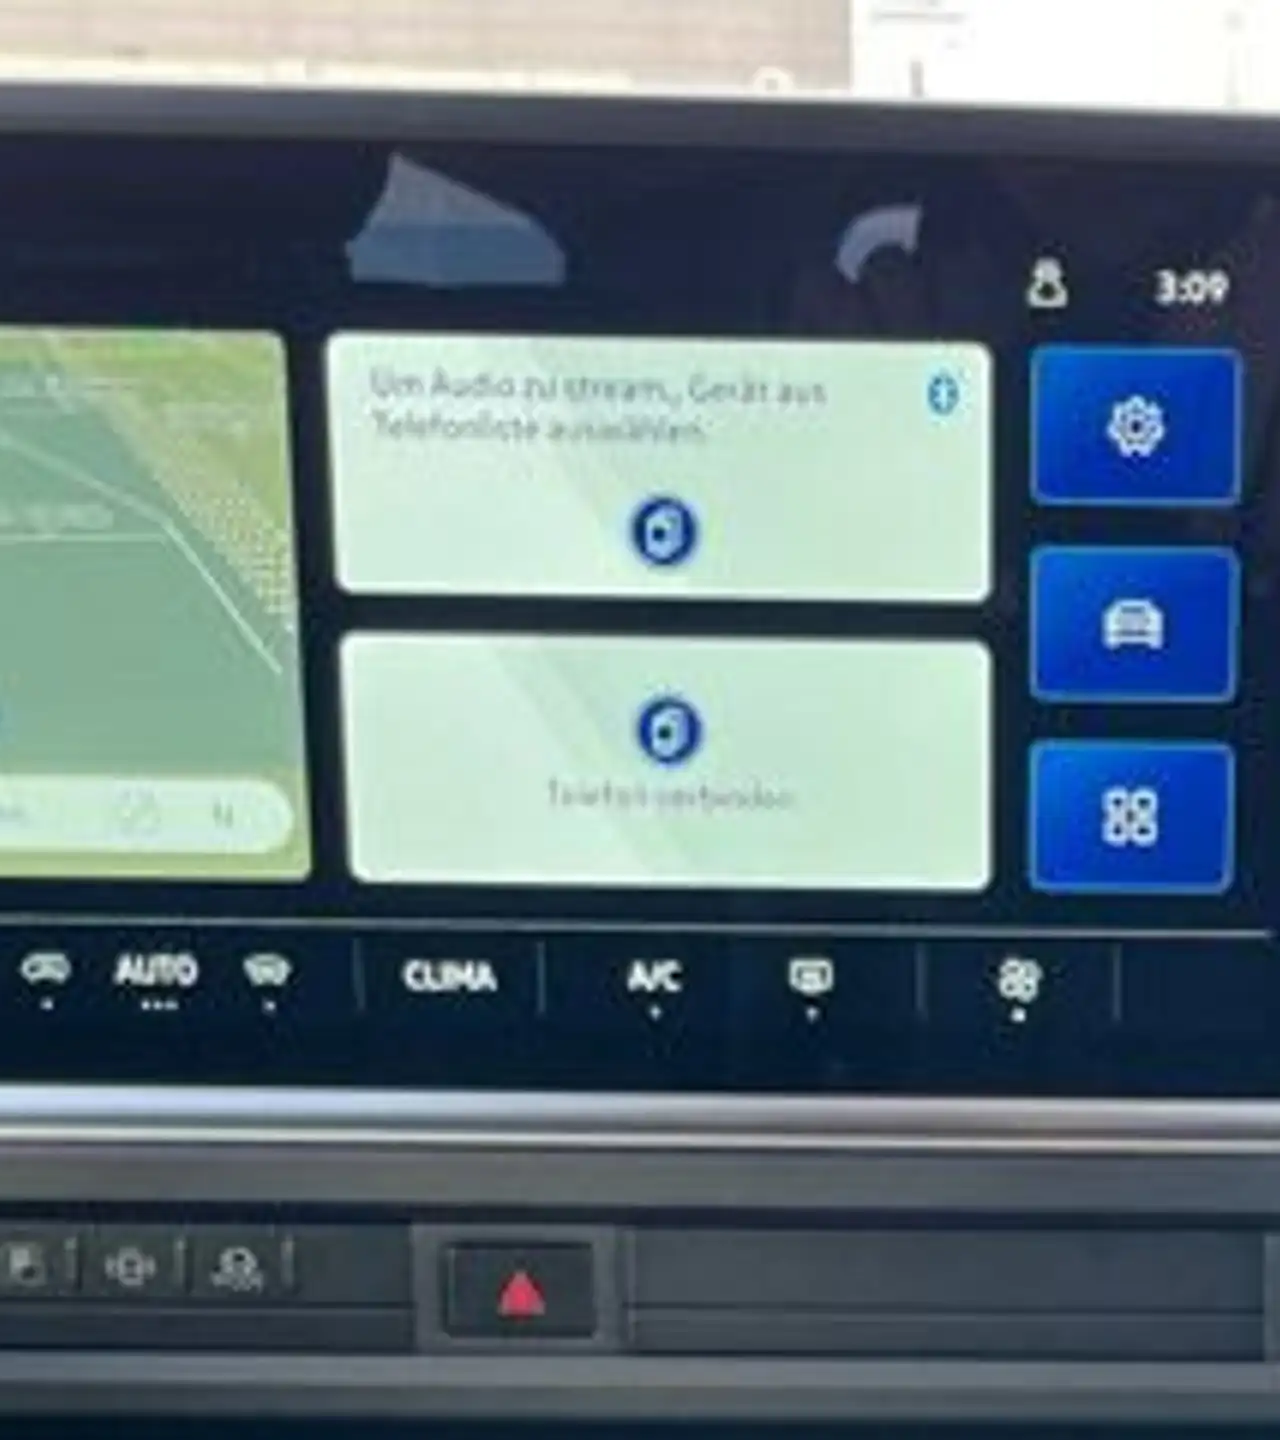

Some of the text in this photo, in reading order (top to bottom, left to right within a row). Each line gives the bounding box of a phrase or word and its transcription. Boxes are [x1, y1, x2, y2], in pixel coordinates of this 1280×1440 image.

[1156, 268, 1231, 306] 3:09
[115, 953, 200, 987] AUTO
[402, 959, 499, 993] CLIMA
[628, 959, 683, 993] A/C
